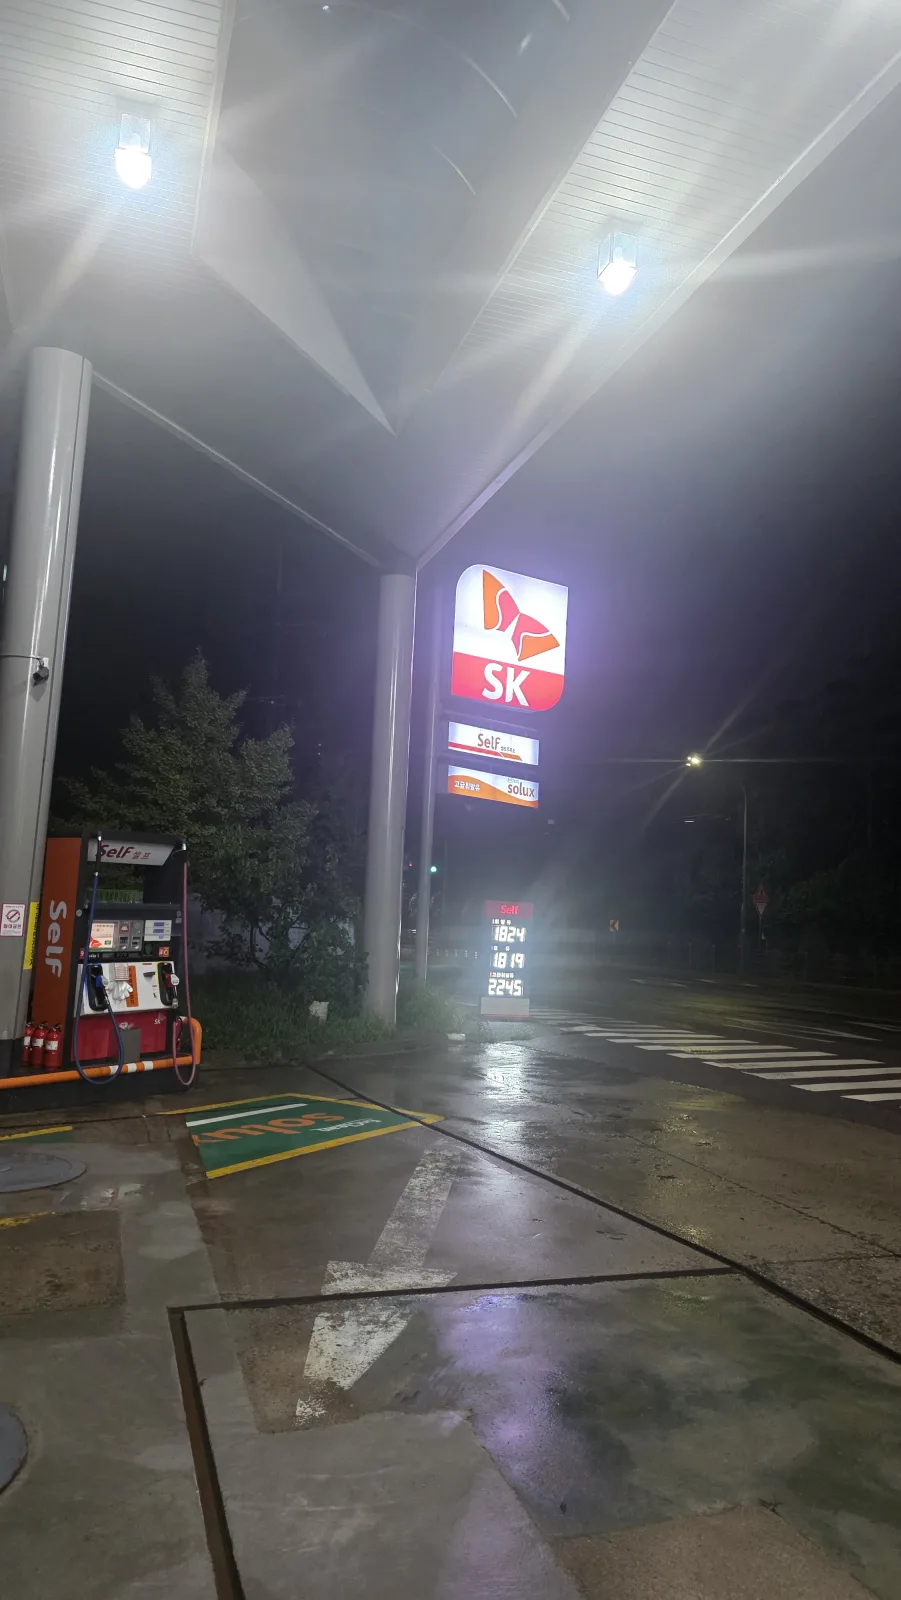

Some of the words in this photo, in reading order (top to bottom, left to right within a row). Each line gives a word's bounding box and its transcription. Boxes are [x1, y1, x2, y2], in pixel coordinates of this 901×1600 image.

[482, 662, 531, 706] SK
[477, 733, 501, 750] Self
[507, 782, 535, 798] solux
[95, 844, 135, 859] Self
[500, 904, 519, 915] Self
[45, 899, 67, 978] Self
[494, 926, 526, 943] 1824
[493, 952, 524, 969] 1819
[488, 978, 522, 996] 2245
